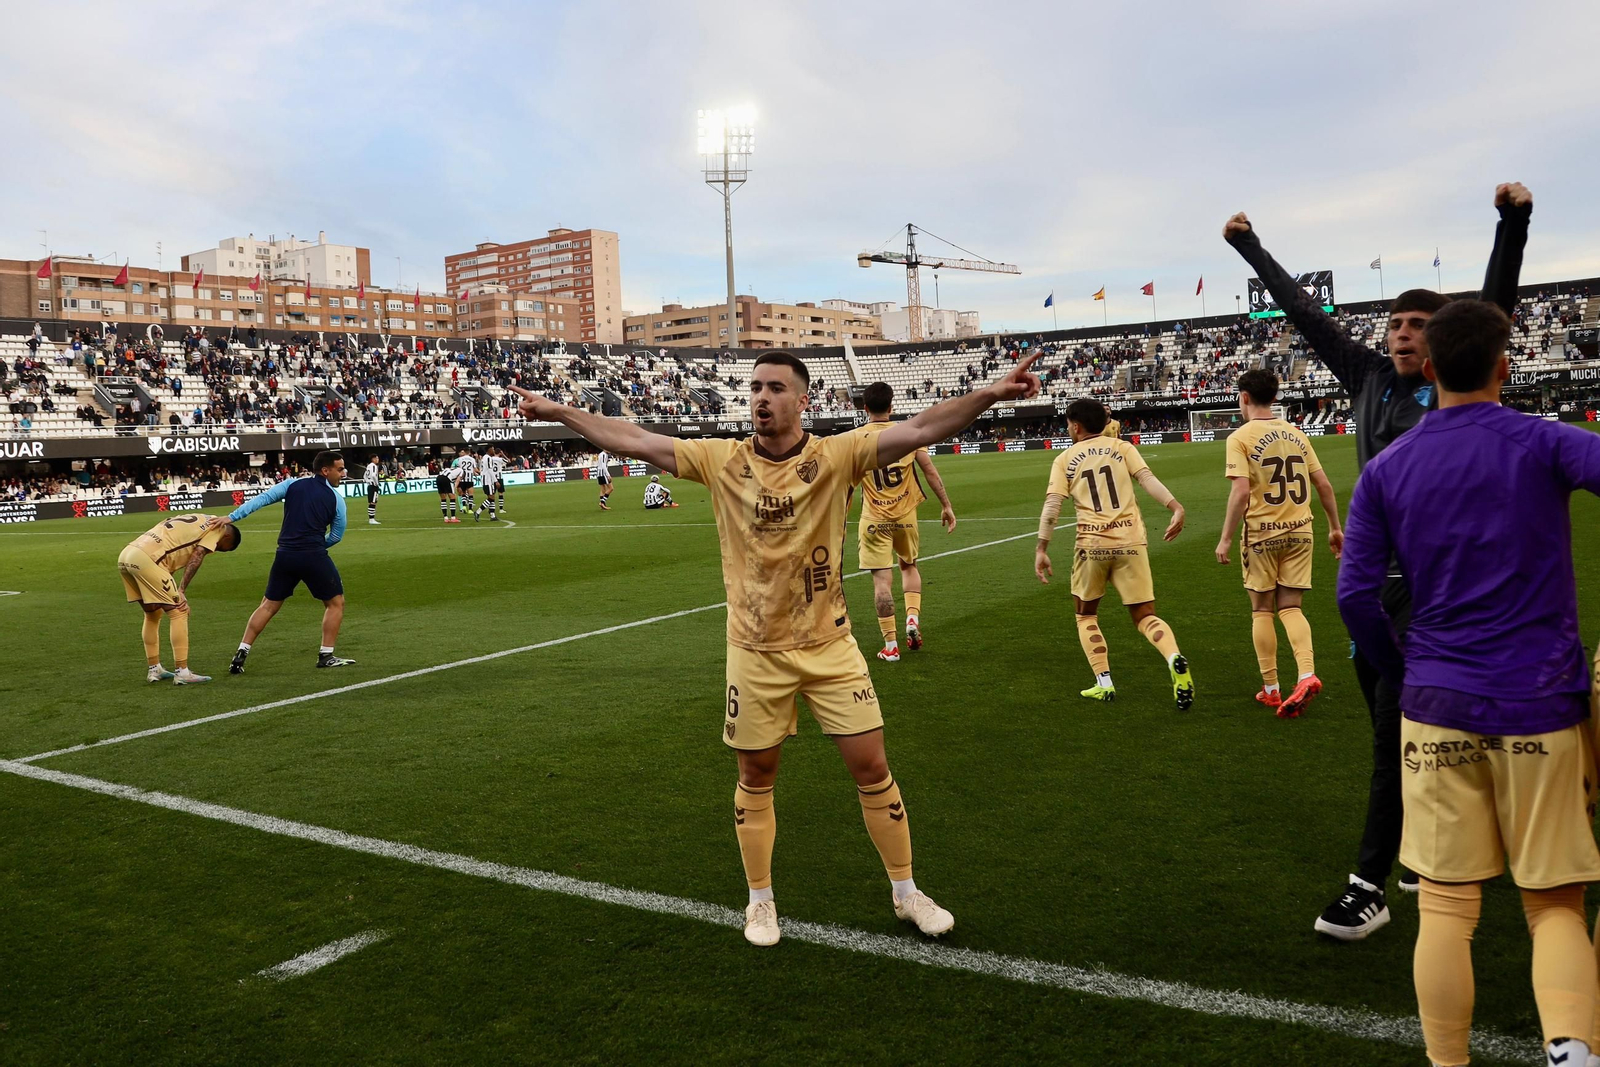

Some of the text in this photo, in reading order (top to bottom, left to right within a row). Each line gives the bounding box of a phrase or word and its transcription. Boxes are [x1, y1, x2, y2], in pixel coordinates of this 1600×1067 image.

[1252, 291, 1259, 304] 0
[1321, 285, 1329, 299] 0
[1511, 373, 1526, 385] FCC
[1195, 394, 1235, 404] CABISUAR
[350, 434, 367, 445] 0 1
[471, 428, 523, 441] CABISUAR
[162, 436, 240, 453] CABISUAR
[1250, 430, 1280, 462] AARON
[461, 461, 472, 471] 22
[1066, 448, 1123, 479] KEVIN MEDNA
[872, 465, 903, 492] 16
[1261, 455, 1308, 506] 35
[1081, 465, 1120, 512] 11
[755, 501, 796, 523] laga
[1082, 519, 1133, 532] BENAHAVIS
[1264, 538, 1287, 547] COSTA
[811, 545, 832, 592] Olin
[727, 684, 739, 719] 6
[1422, 739, 1476, 755] COSTA
[1511, 741, 1549, 755] SOL
